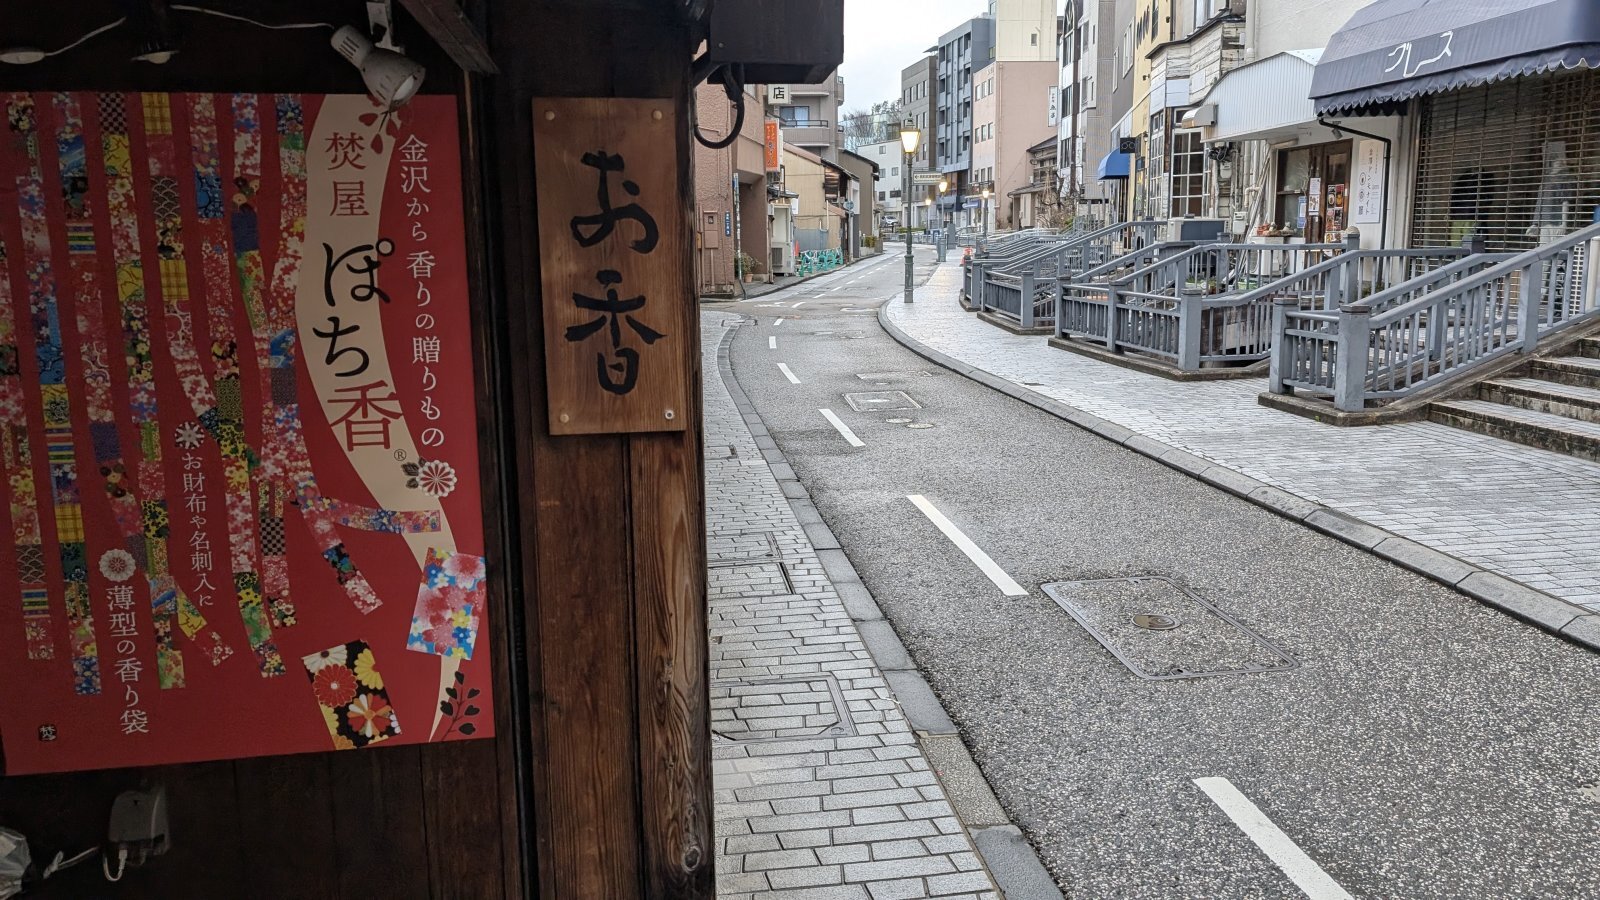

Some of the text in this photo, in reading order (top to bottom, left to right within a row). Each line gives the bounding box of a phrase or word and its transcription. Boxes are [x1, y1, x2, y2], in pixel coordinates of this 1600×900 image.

[773, 86, 785, 100] 店
[312, 236, 404, 452] ぽち香
[398, 134, 446, 449] 金沢から香りの贈りもの
[564, 150, 668, 396] お香
[182, 451, 216, 608] お財布や名刺入に
[105, 583, 151, 735] 薄型の香り袋
